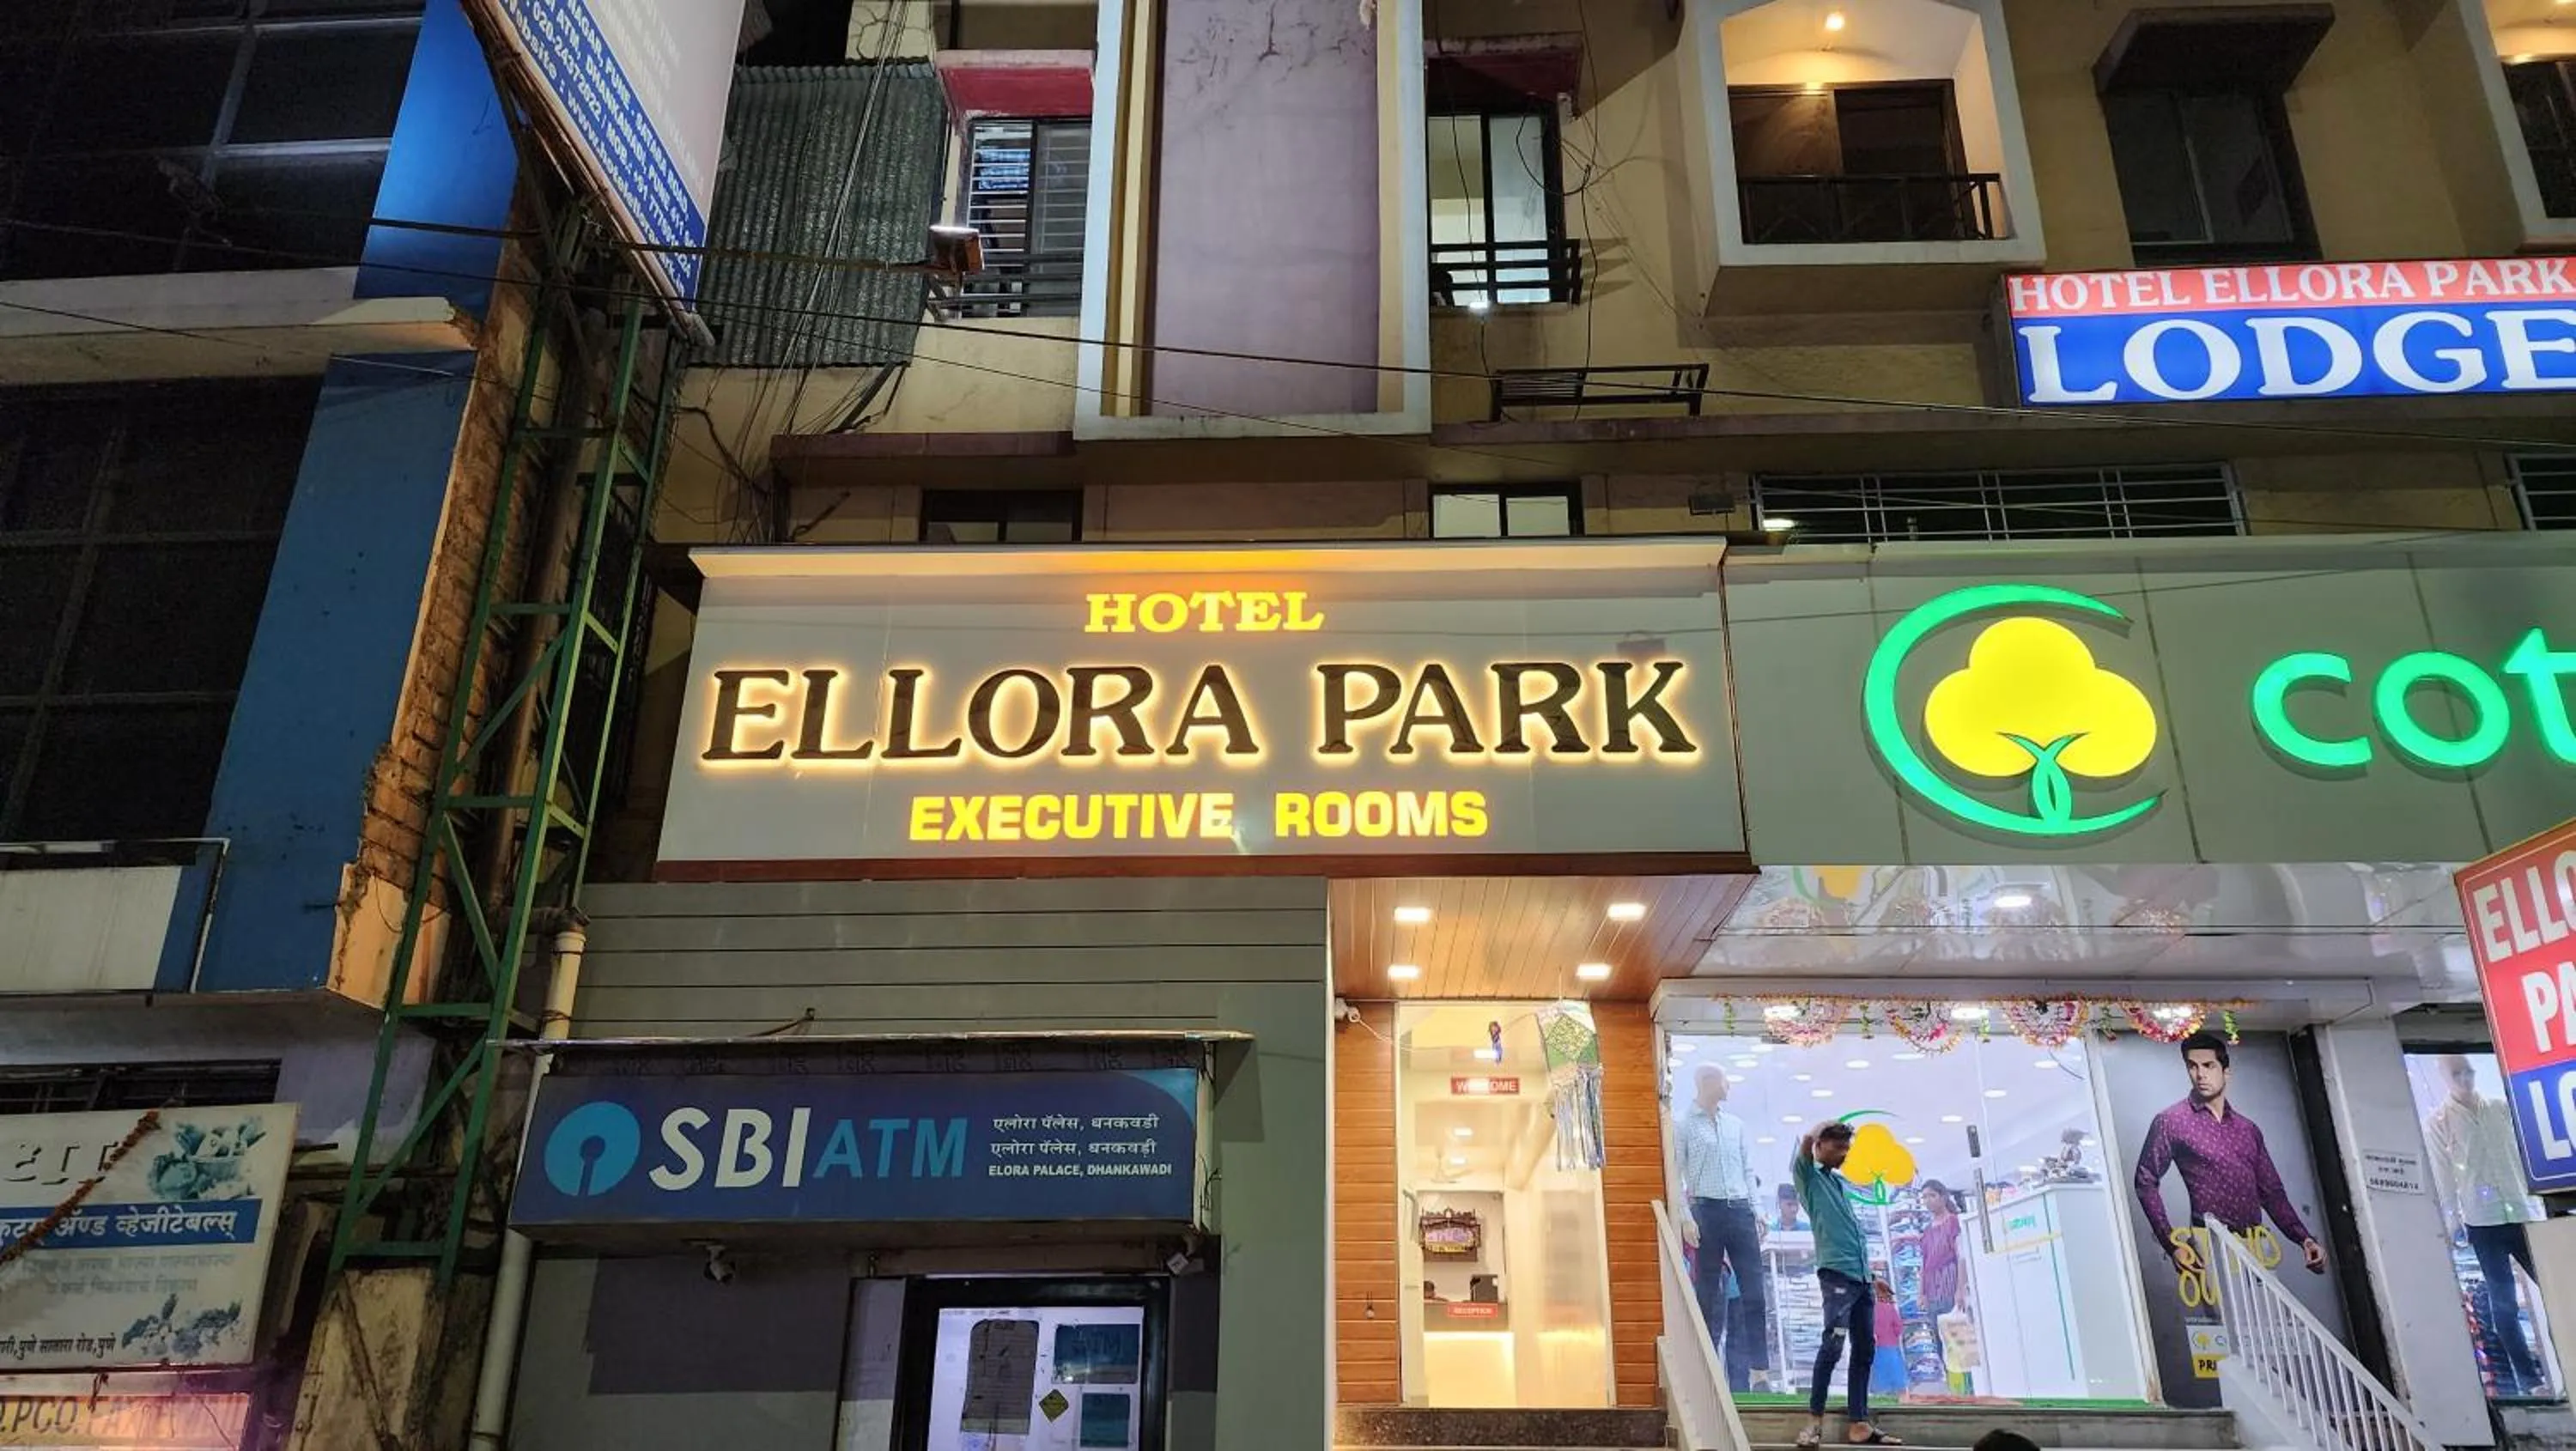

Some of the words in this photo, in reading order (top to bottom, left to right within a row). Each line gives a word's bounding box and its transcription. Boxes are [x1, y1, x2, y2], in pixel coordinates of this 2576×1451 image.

[2010, 272, 2190, 313] HOTEL
[2199, 263, 2415, 305] ELLORA
[2423, 258, 2576, 297] PARK
[2018, 309, 2576, 403] LODGE
[1084, 590, 1325, 633] HOTEL
[702, 665, 1261, 761] ELLORA
[1315, 659, 1698, 756] PARK
[908, 792, 1234, 841] EXECUTIVE
[1275, 791, 1488, 838] ROOMS
[1456, 1080, 1518, 1093] WOME
[993, 1114, 1036, 1132] एलोरा
[648, 1106, 811, 1191] SBI
[812, 1118, 968, 1179] ATM
[988, 1165, 1030, 1176] ELORA
[1033, 1164, 1084, 1177] PALACE,
[1087, 1163, 1172, 1175] DHANKAWADI
[990, 1139, 1035, 1157] एलोरा
[2170, 1225, 2281, 1274] STND
